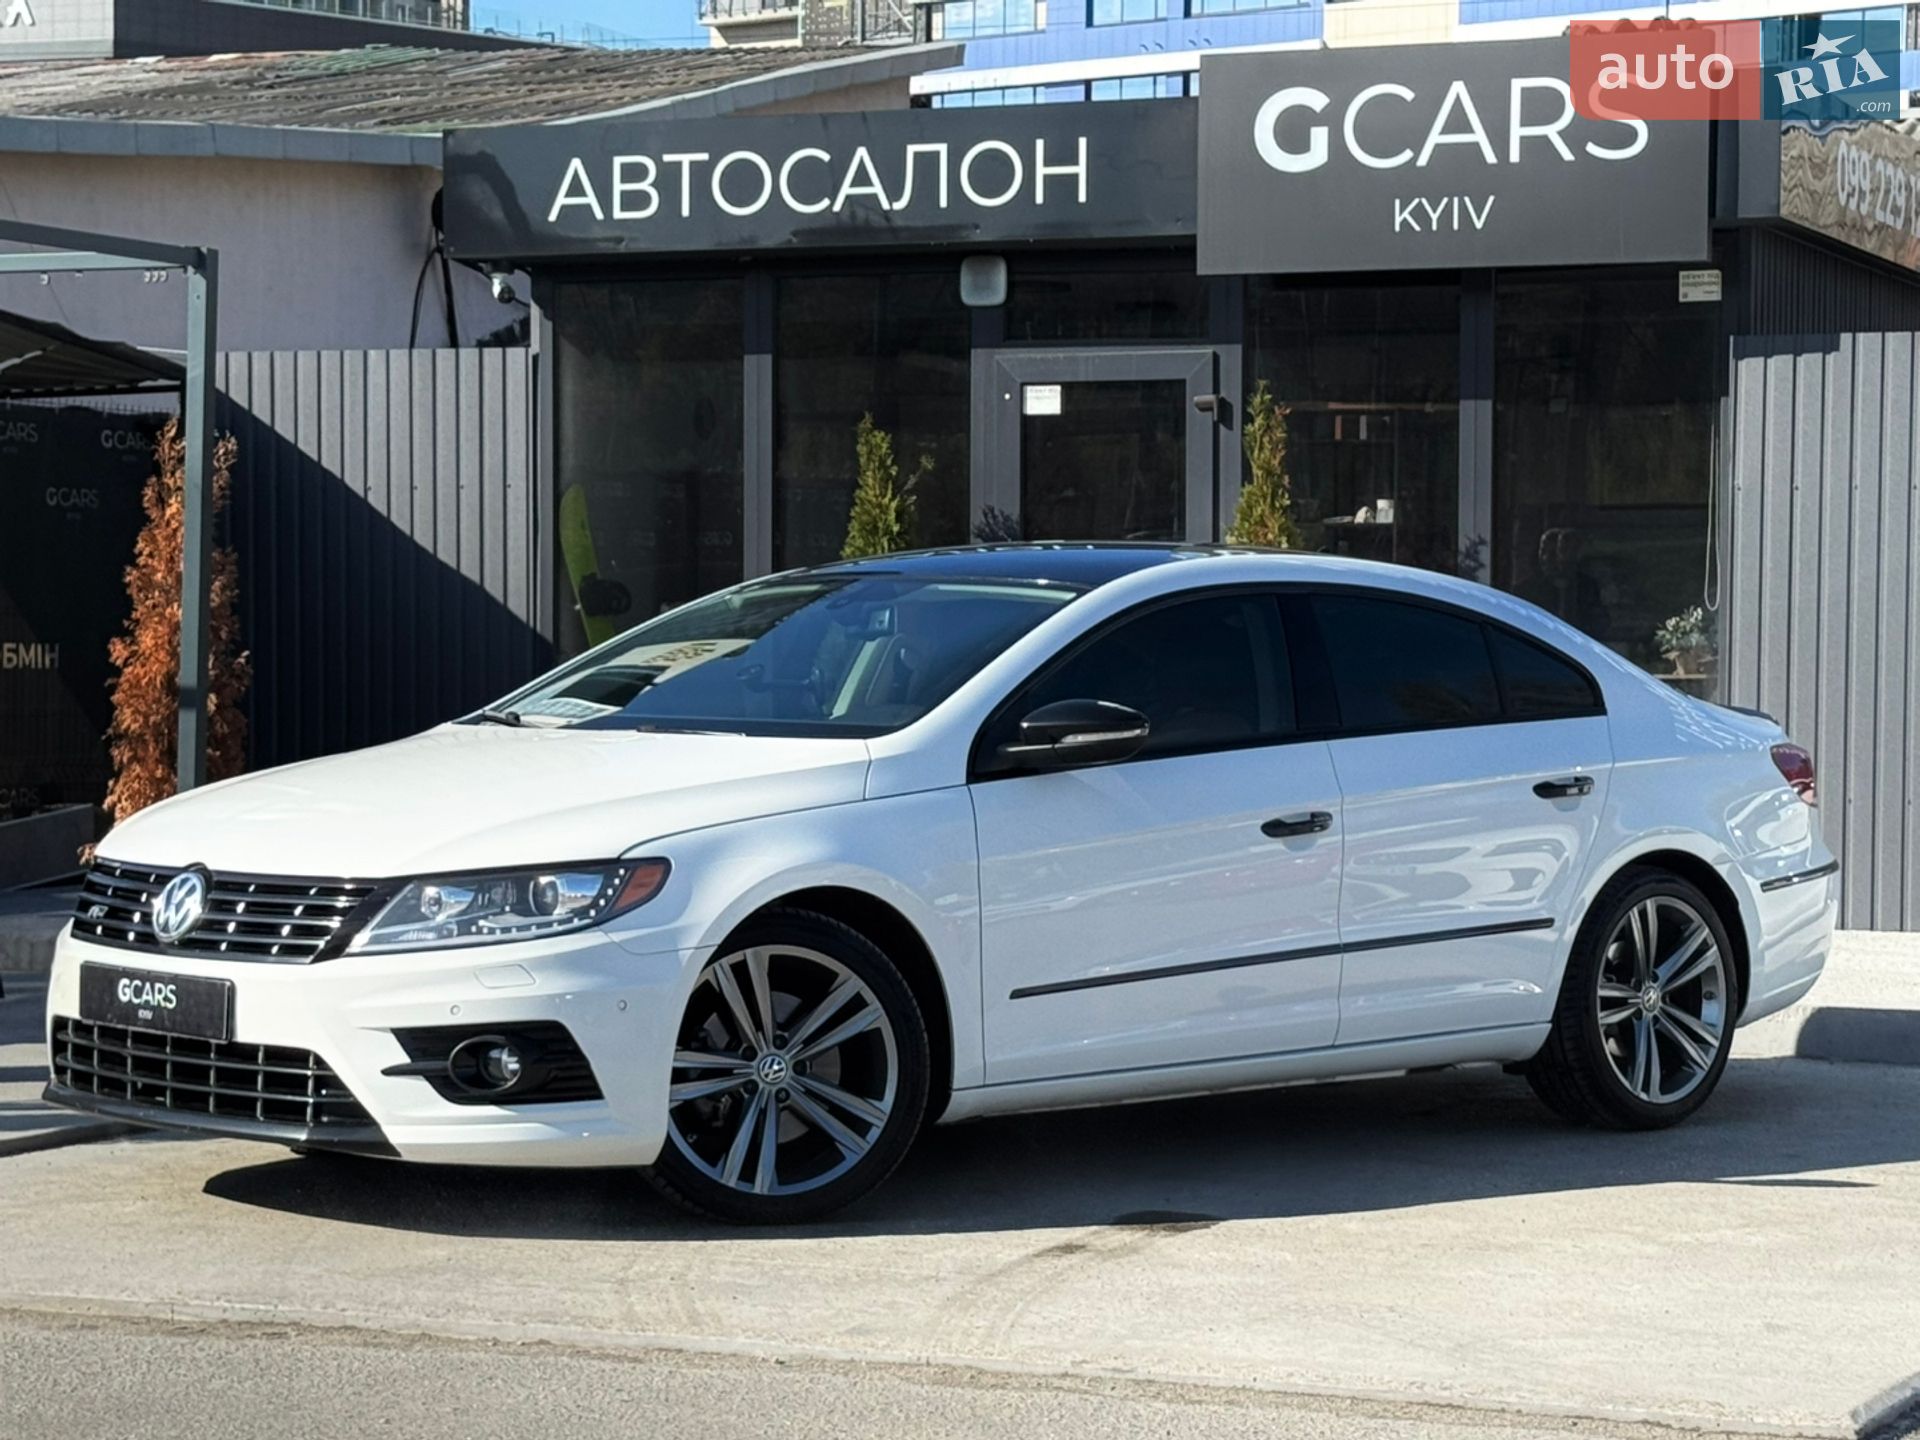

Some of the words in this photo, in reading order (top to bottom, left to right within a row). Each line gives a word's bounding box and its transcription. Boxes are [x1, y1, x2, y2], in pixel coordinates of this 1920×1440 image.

[1253, 76, 1650, 173] GCARS
[548, 136, 1088, 222] АВТОСАЛОН
[1837, 139, 1870, 216] 099
[1394, 195, 1495, 232] KYIV
[100, 429, 151, 450] GCAR
[45, 486, 99, 509] GCARS
[0, 642, 60, 669] БМІН
[117, 977, 177, 1009] GCARS
